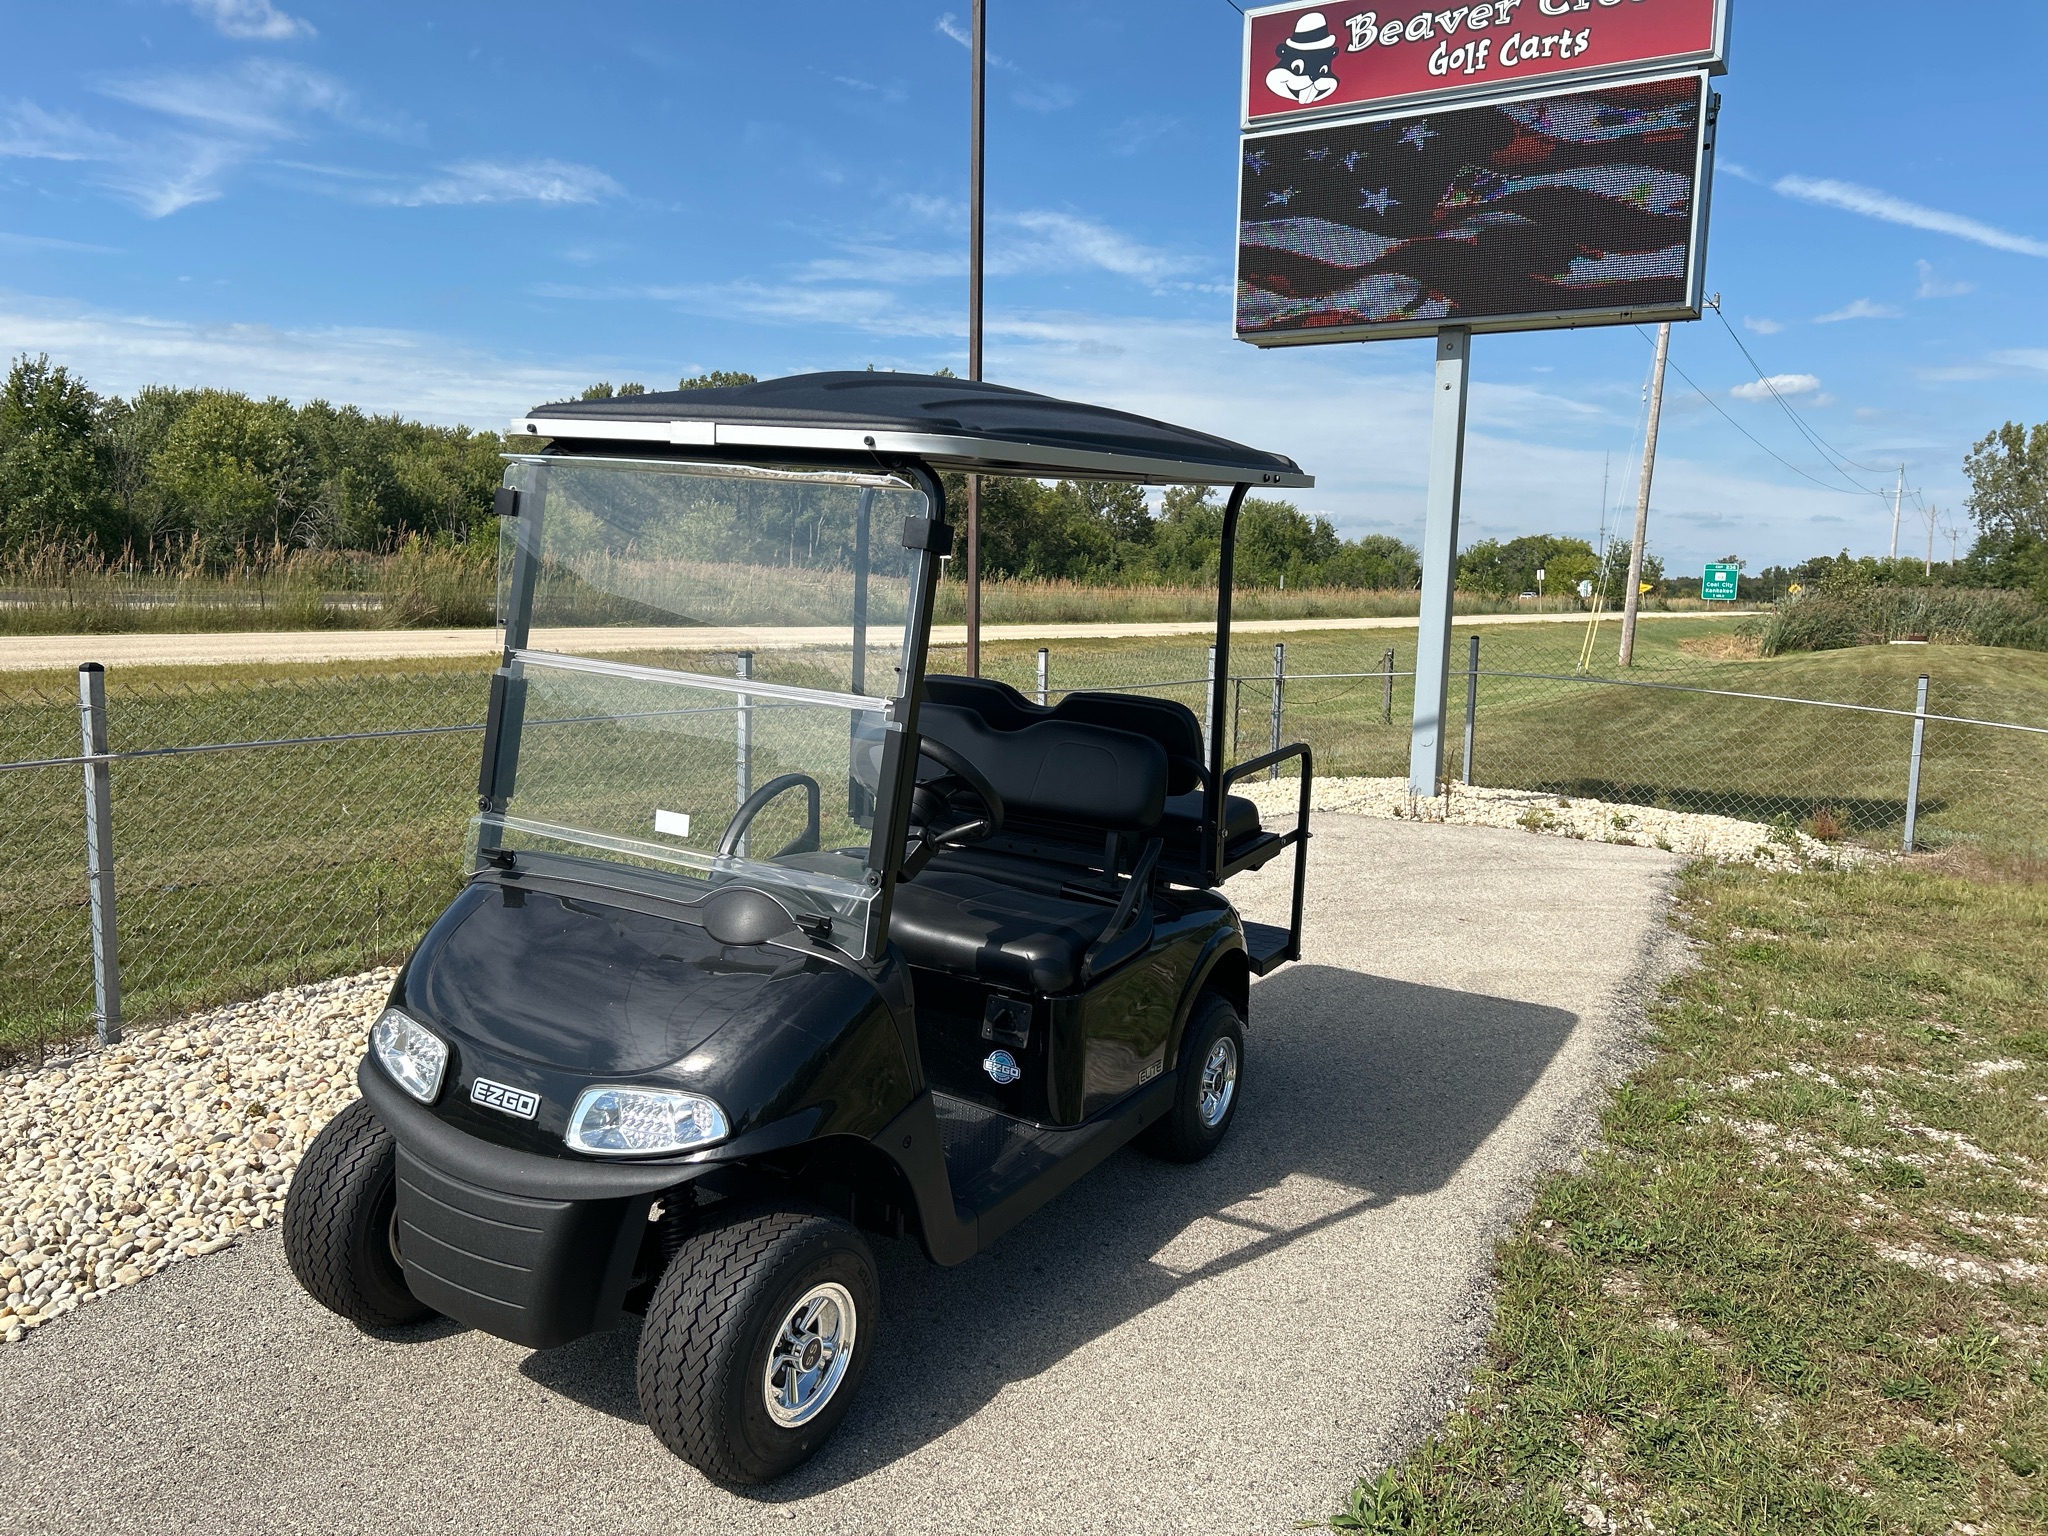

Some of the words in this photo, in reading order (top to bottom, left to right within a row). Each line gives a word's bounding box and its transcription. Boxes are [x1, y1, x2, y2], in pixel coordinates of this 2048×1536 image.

[1345, 0, 1521, 52] Beaver
[1428, 39, 1491, 76] Golf
[1499, 28, 1591, 67] Carts
[985, 1060, 1019, 1077] EZGO
[1140, 1061, 1162, 1082] ELITE
[473, 1082, 535, 1115] EZGO
